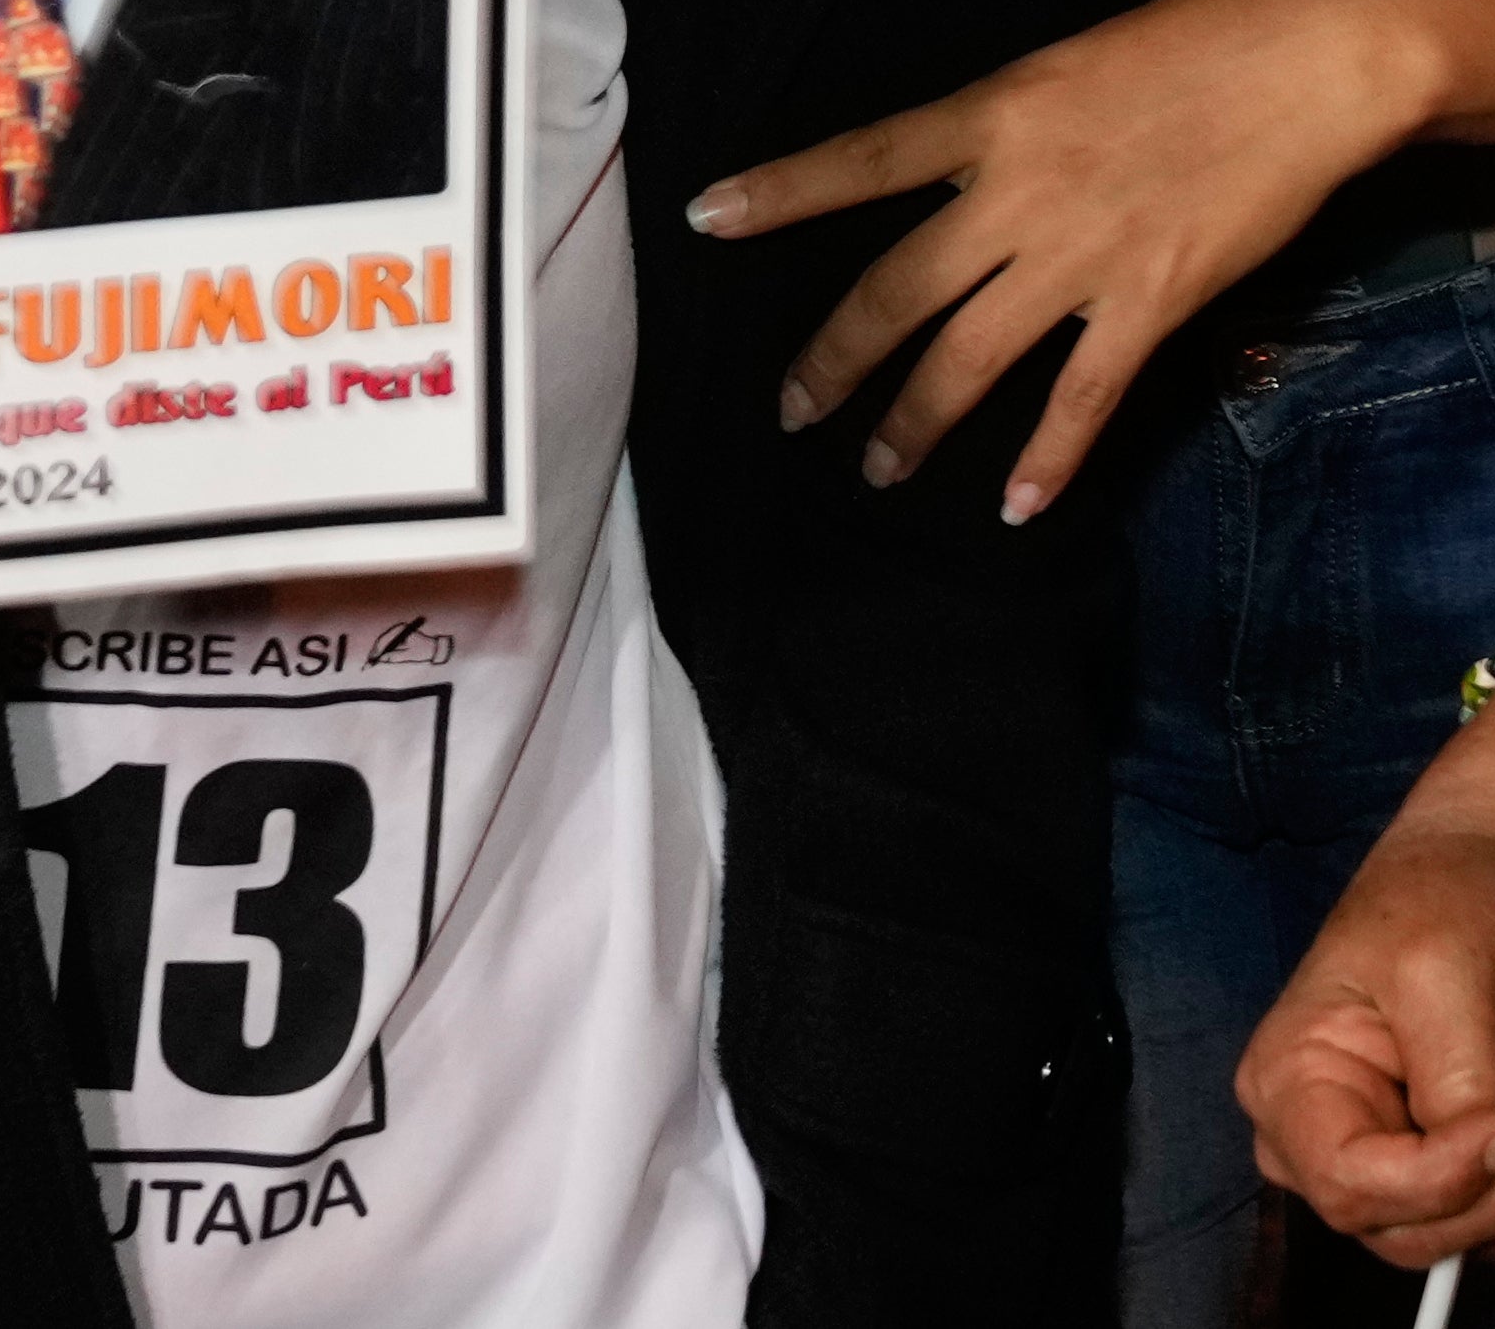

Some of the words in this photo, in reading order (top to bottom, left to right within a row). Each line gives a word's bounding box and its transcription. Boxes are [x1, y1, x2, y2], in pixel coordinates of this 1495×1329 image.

[106, 377, 237, 429] diste
[255, 363, 311, 413] al
[330, 349, 457, 406] Perú
[250, 633, 347, 678] ASI
[19, 759, 374, 1098] 13
